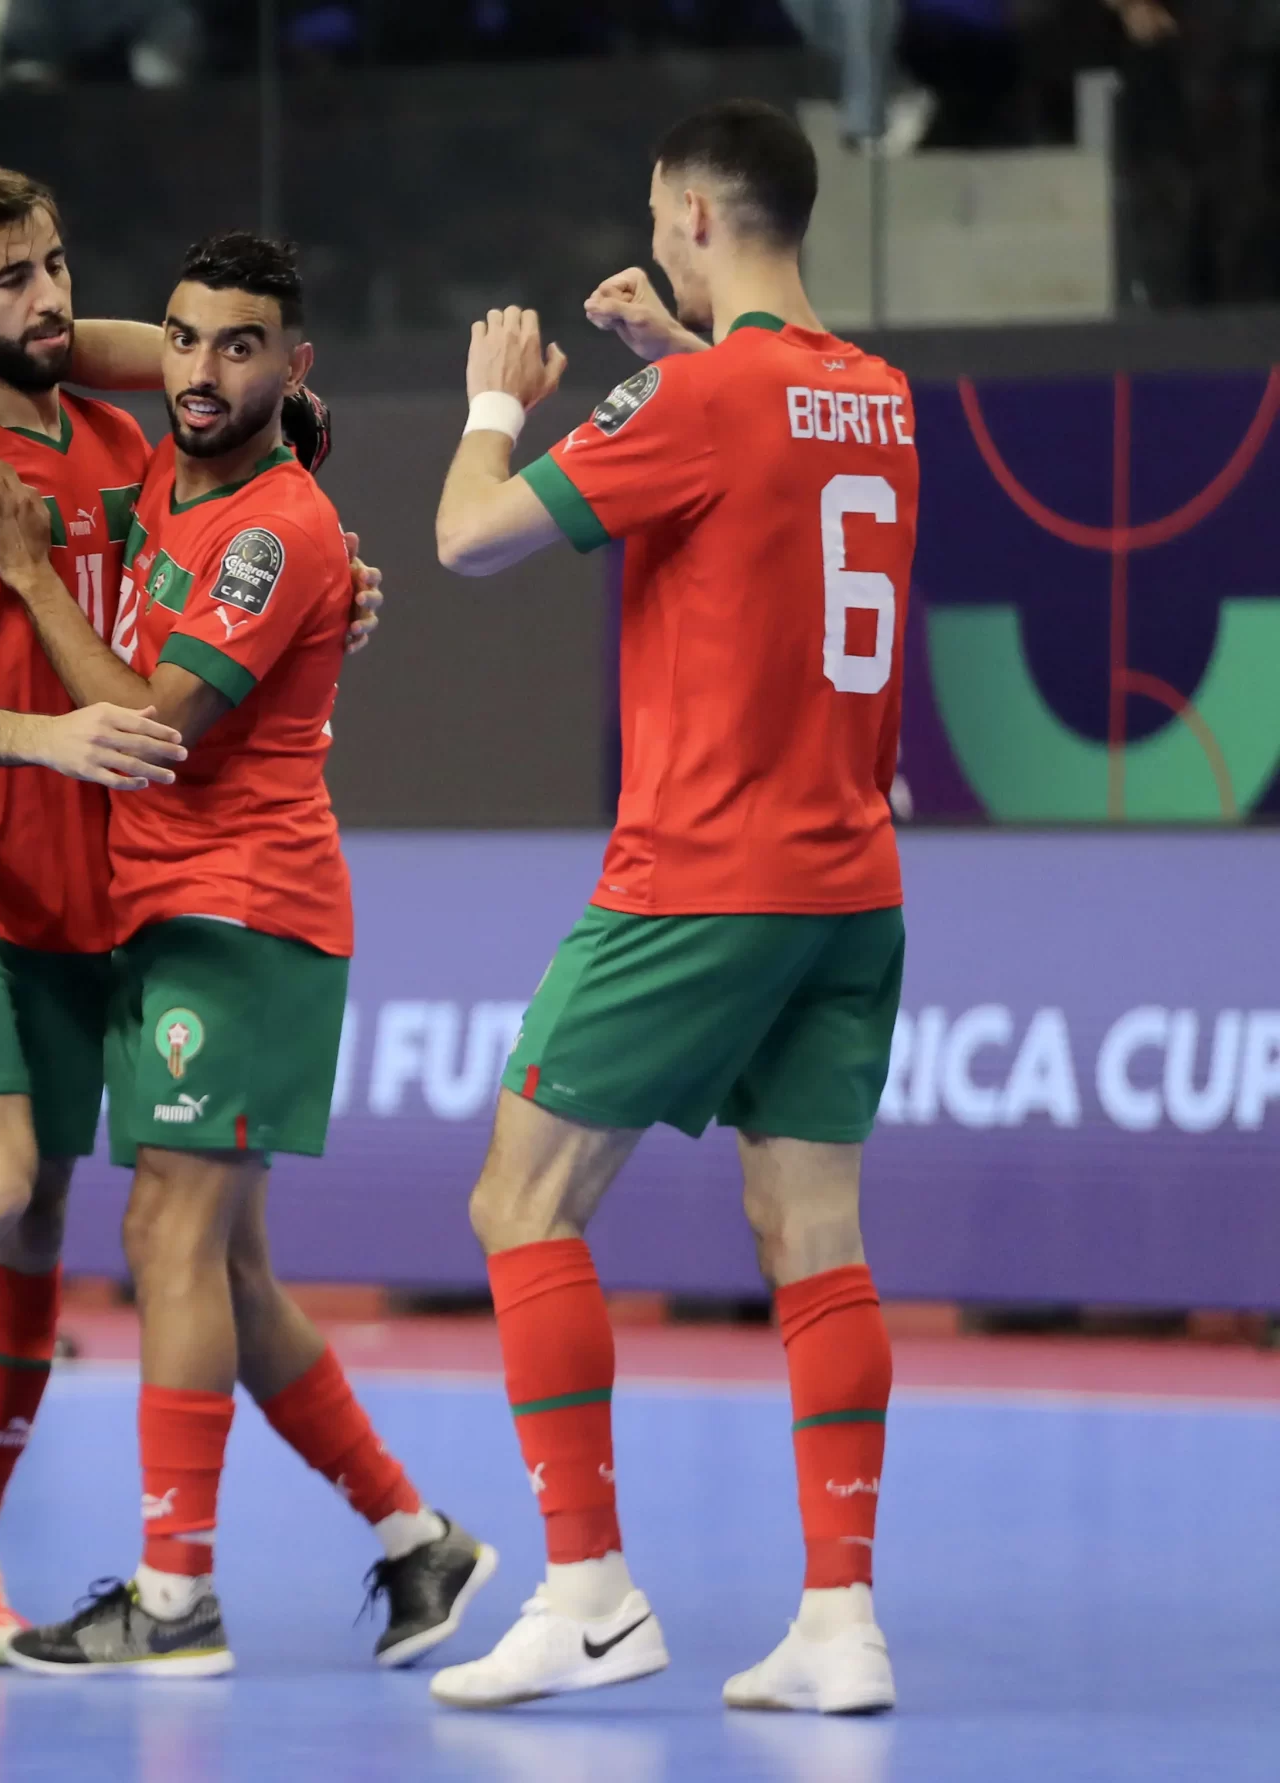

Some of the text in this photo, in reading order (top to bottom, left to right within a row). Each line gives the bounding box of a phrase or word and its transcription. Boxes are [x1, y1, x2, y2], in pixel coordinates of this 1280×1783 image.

[786, 385, 914, 445] BORITE
[225, 555, 275, 582] Celebrate
[225, 566, 262, 586] Africa
[221, 585, 256, 602] CAF
[820, 473, 897, 694] 6
[1095, 1004, 1280, 1133] CUP
[153, 1103, 195, 1123] PUMA
